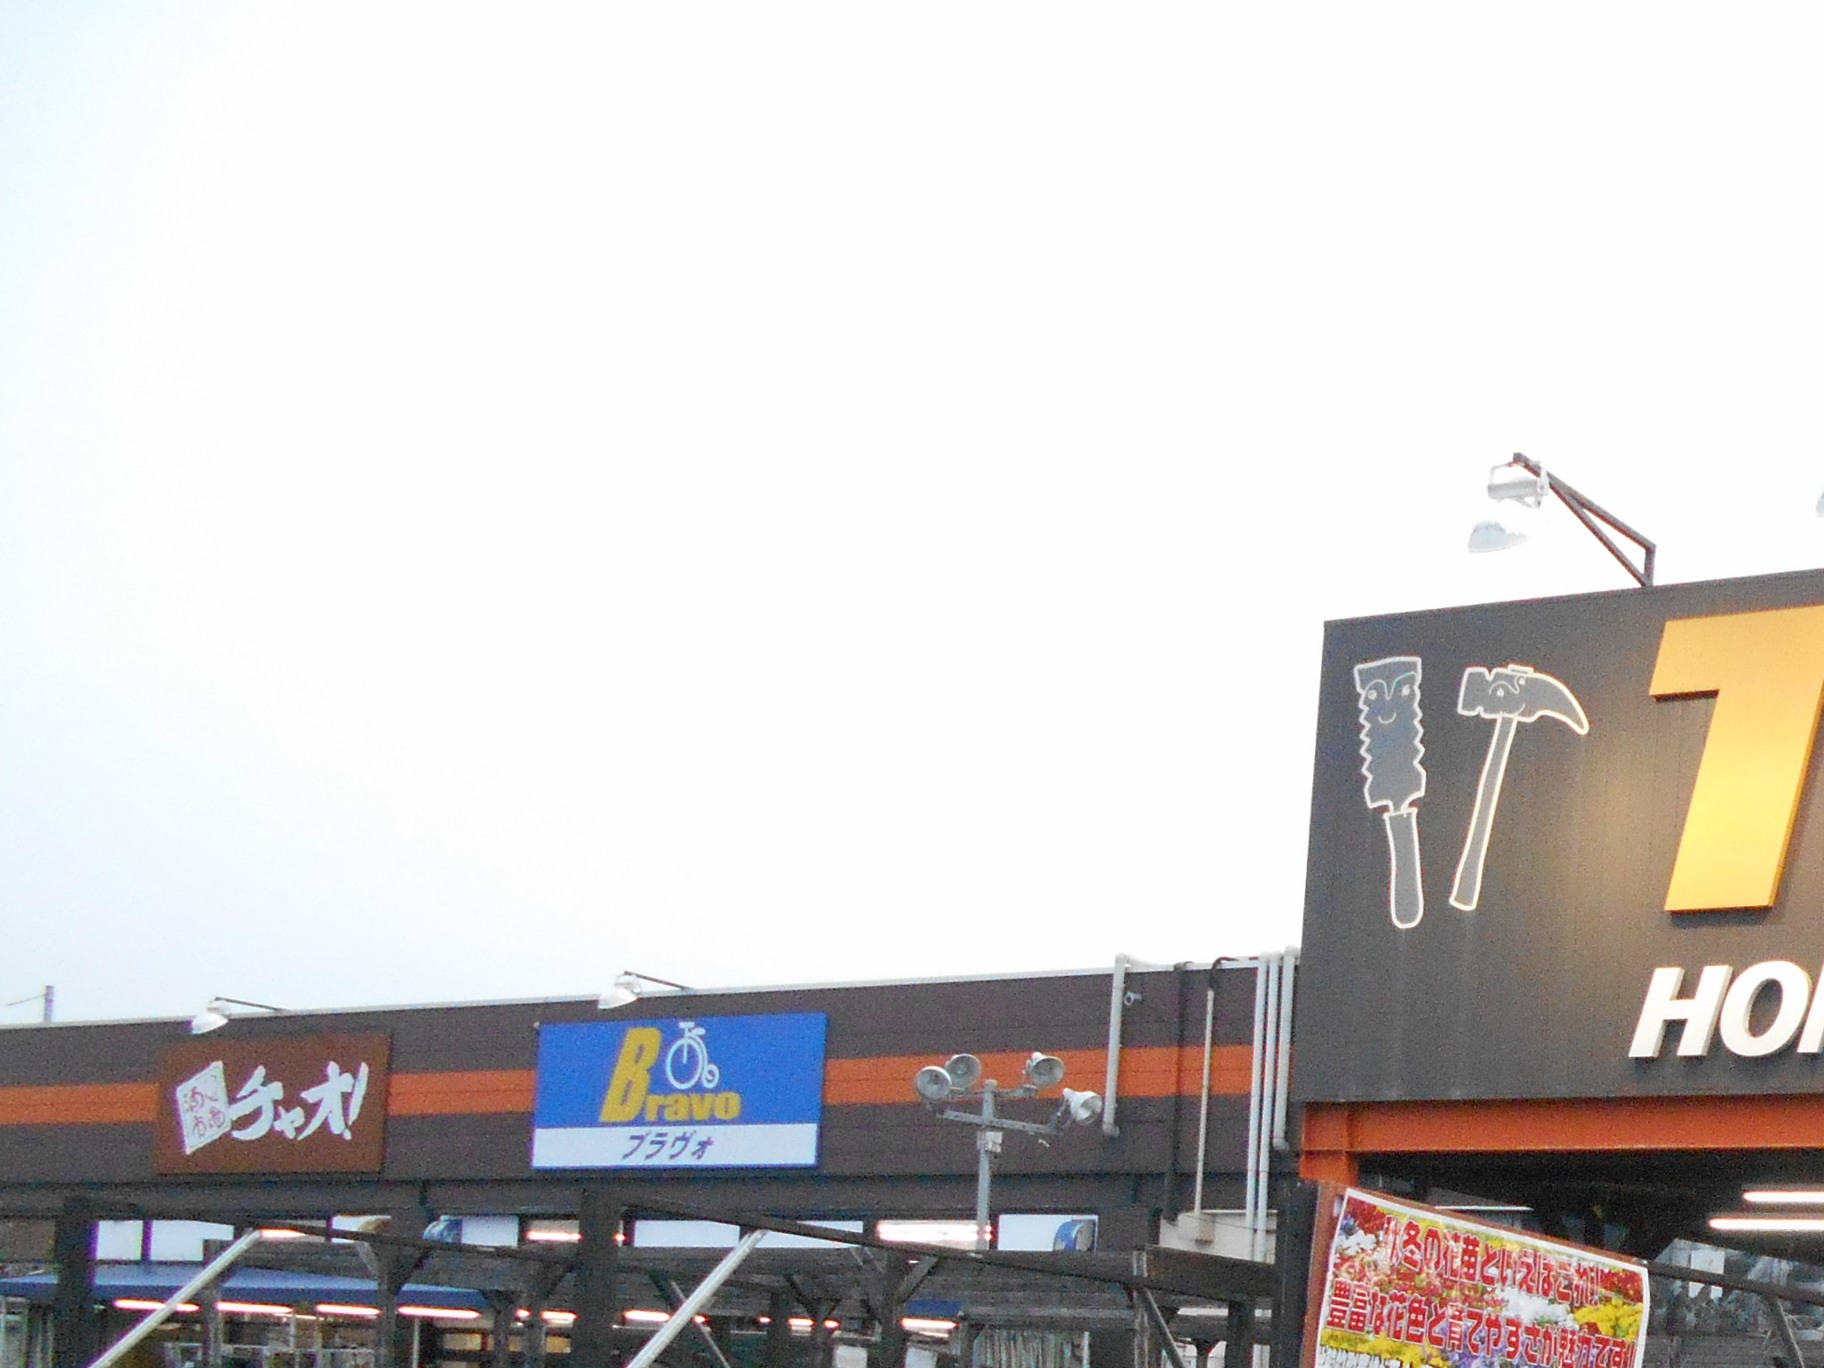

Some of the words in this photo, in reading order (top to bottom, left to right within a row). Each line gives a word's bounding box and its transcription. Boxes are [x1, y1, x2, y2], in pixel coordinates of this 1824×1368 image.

[600, 1026, 743, 1123] Bravo
[621, 1129, 714, 1161] ブラヴォ
